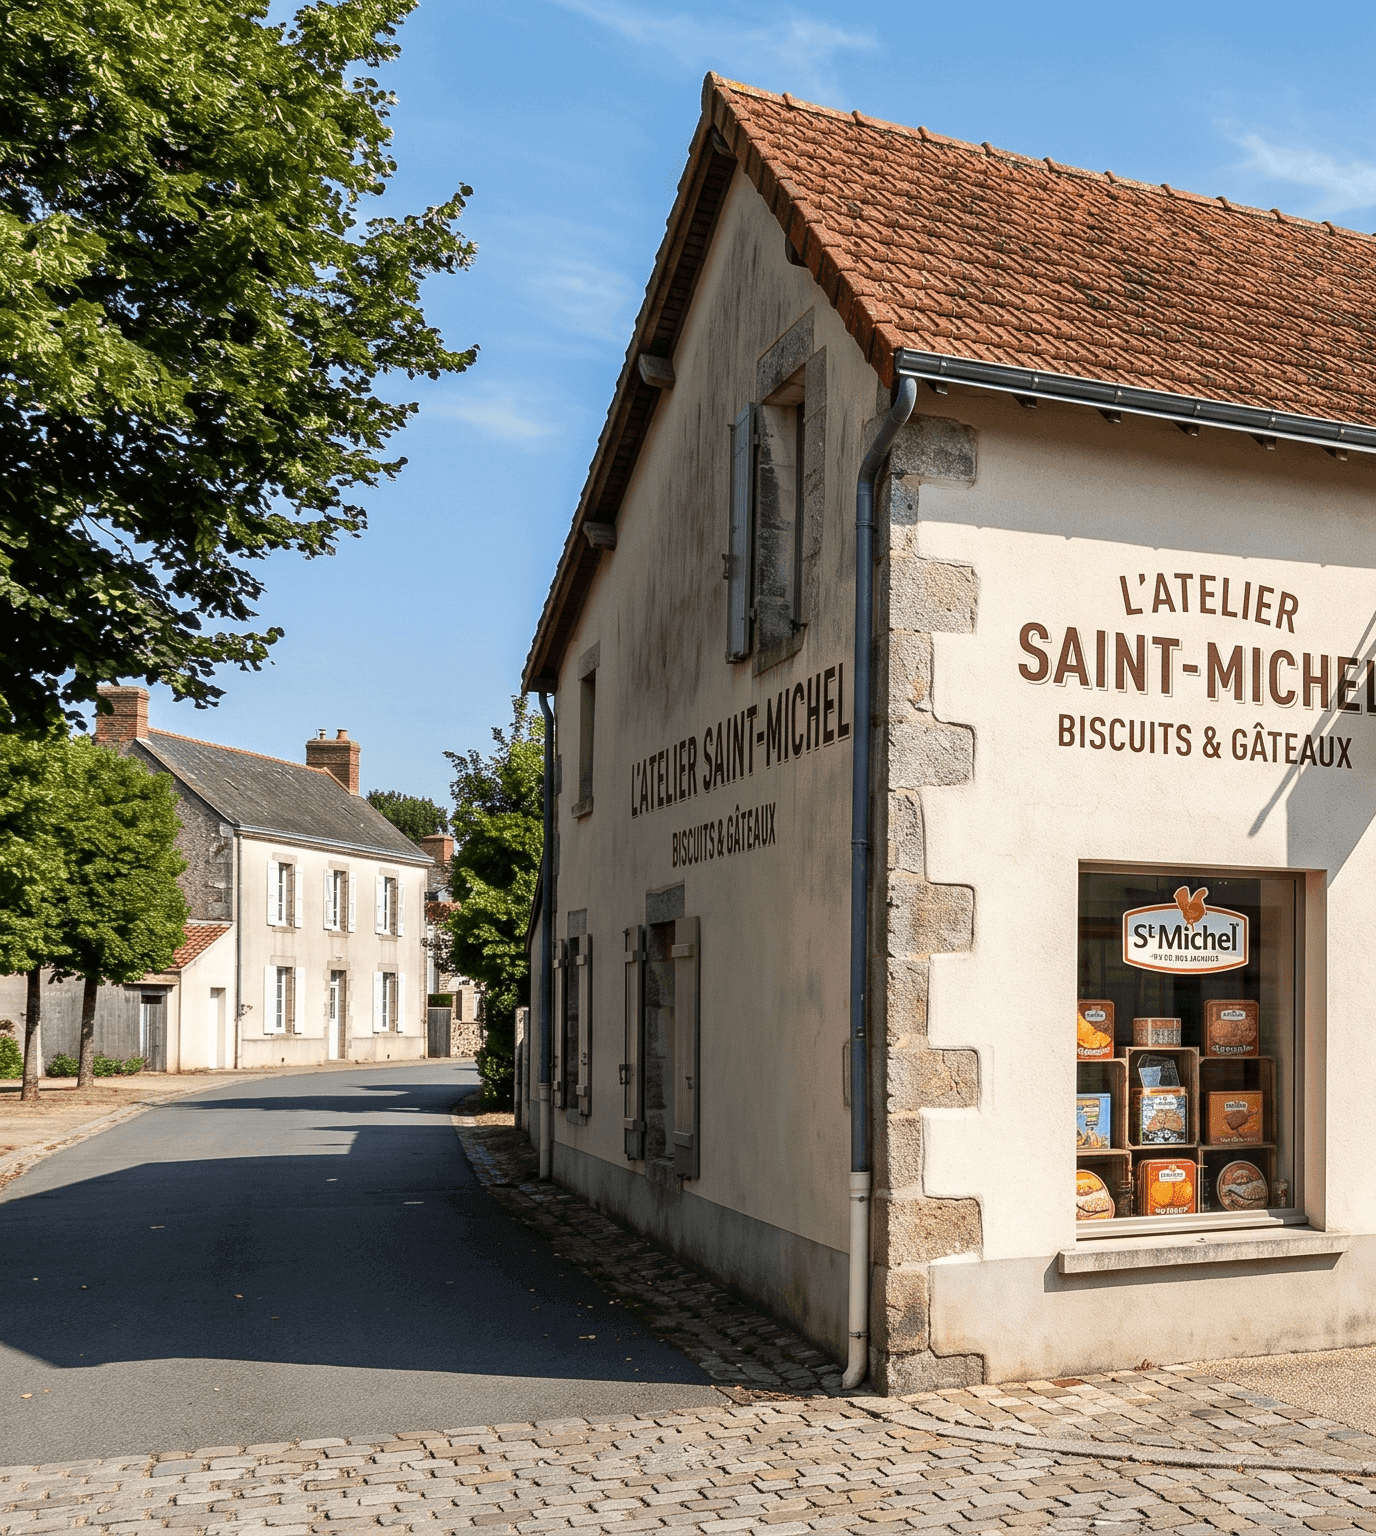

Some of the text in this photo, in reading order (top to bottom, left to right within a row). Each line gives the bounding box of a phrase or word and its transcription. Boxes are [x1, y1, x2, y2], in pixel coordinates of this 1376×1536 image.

[1119, 573, 1299, 634] L'ATELIER
[632, 662, 850, 818] L'ATELIER SAINT-MICHEL
[1058, 713, 1353, 769] BISCUITS & GÂTEAUX
[672, 803, 776, 868] BISCUITS & GÂTEAUX
